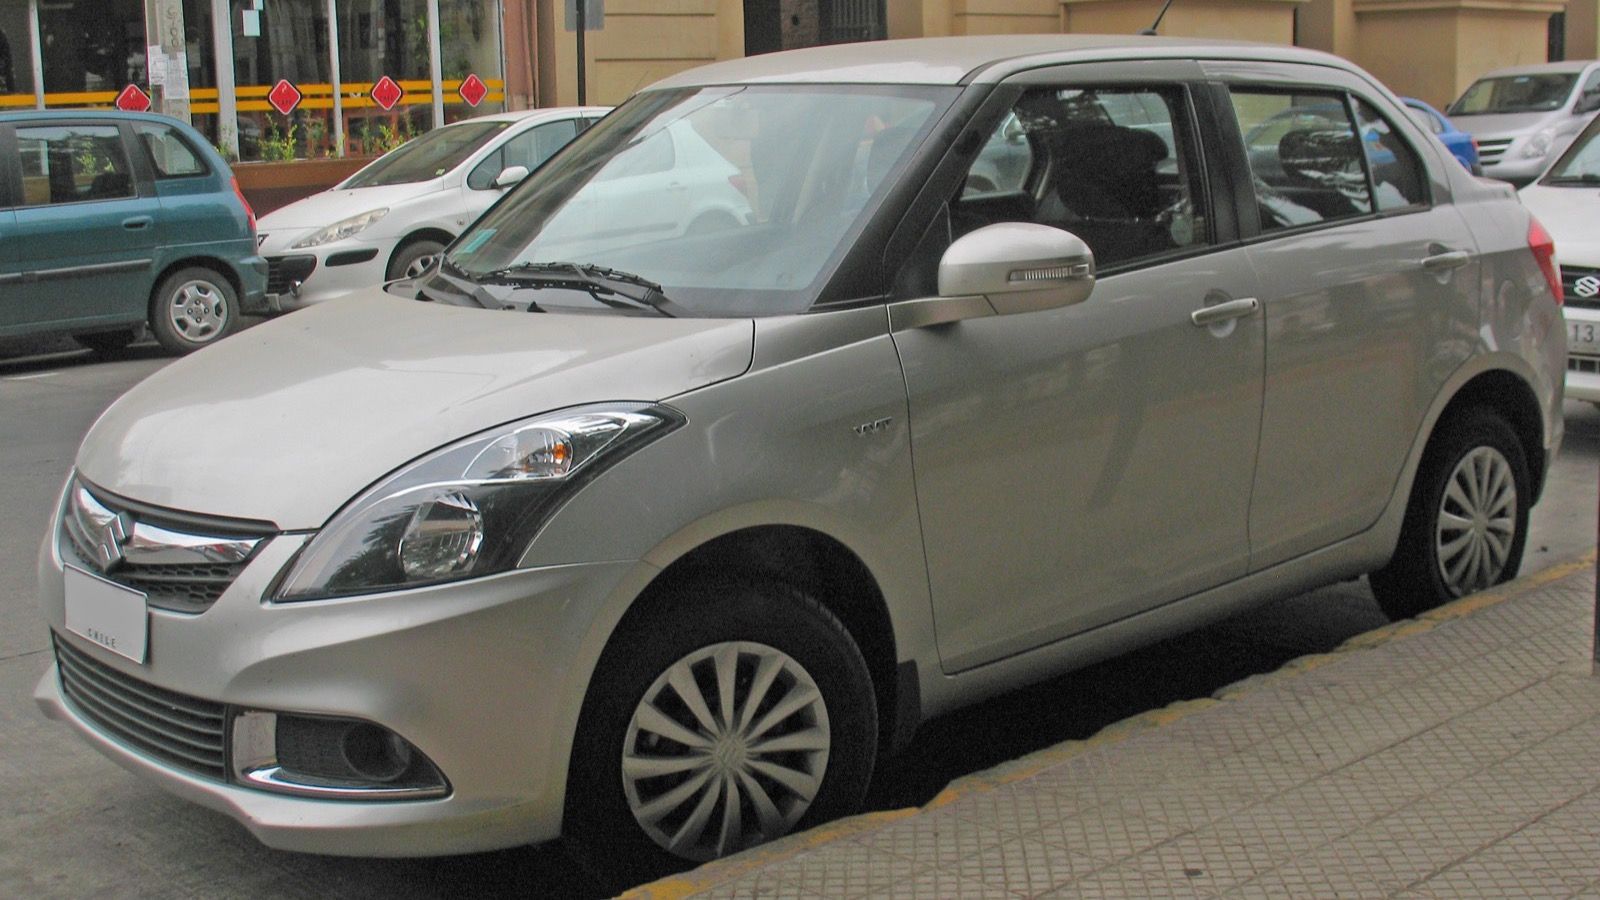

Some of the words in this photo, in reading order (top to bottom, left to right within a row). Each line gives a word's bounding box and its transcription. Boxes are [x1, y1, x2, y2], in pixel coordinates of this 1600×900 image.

[1573, 324, 1594, 343] 13
[852, 416, 892, 437] VVT
[88, 628, 116, 648] CHILE
